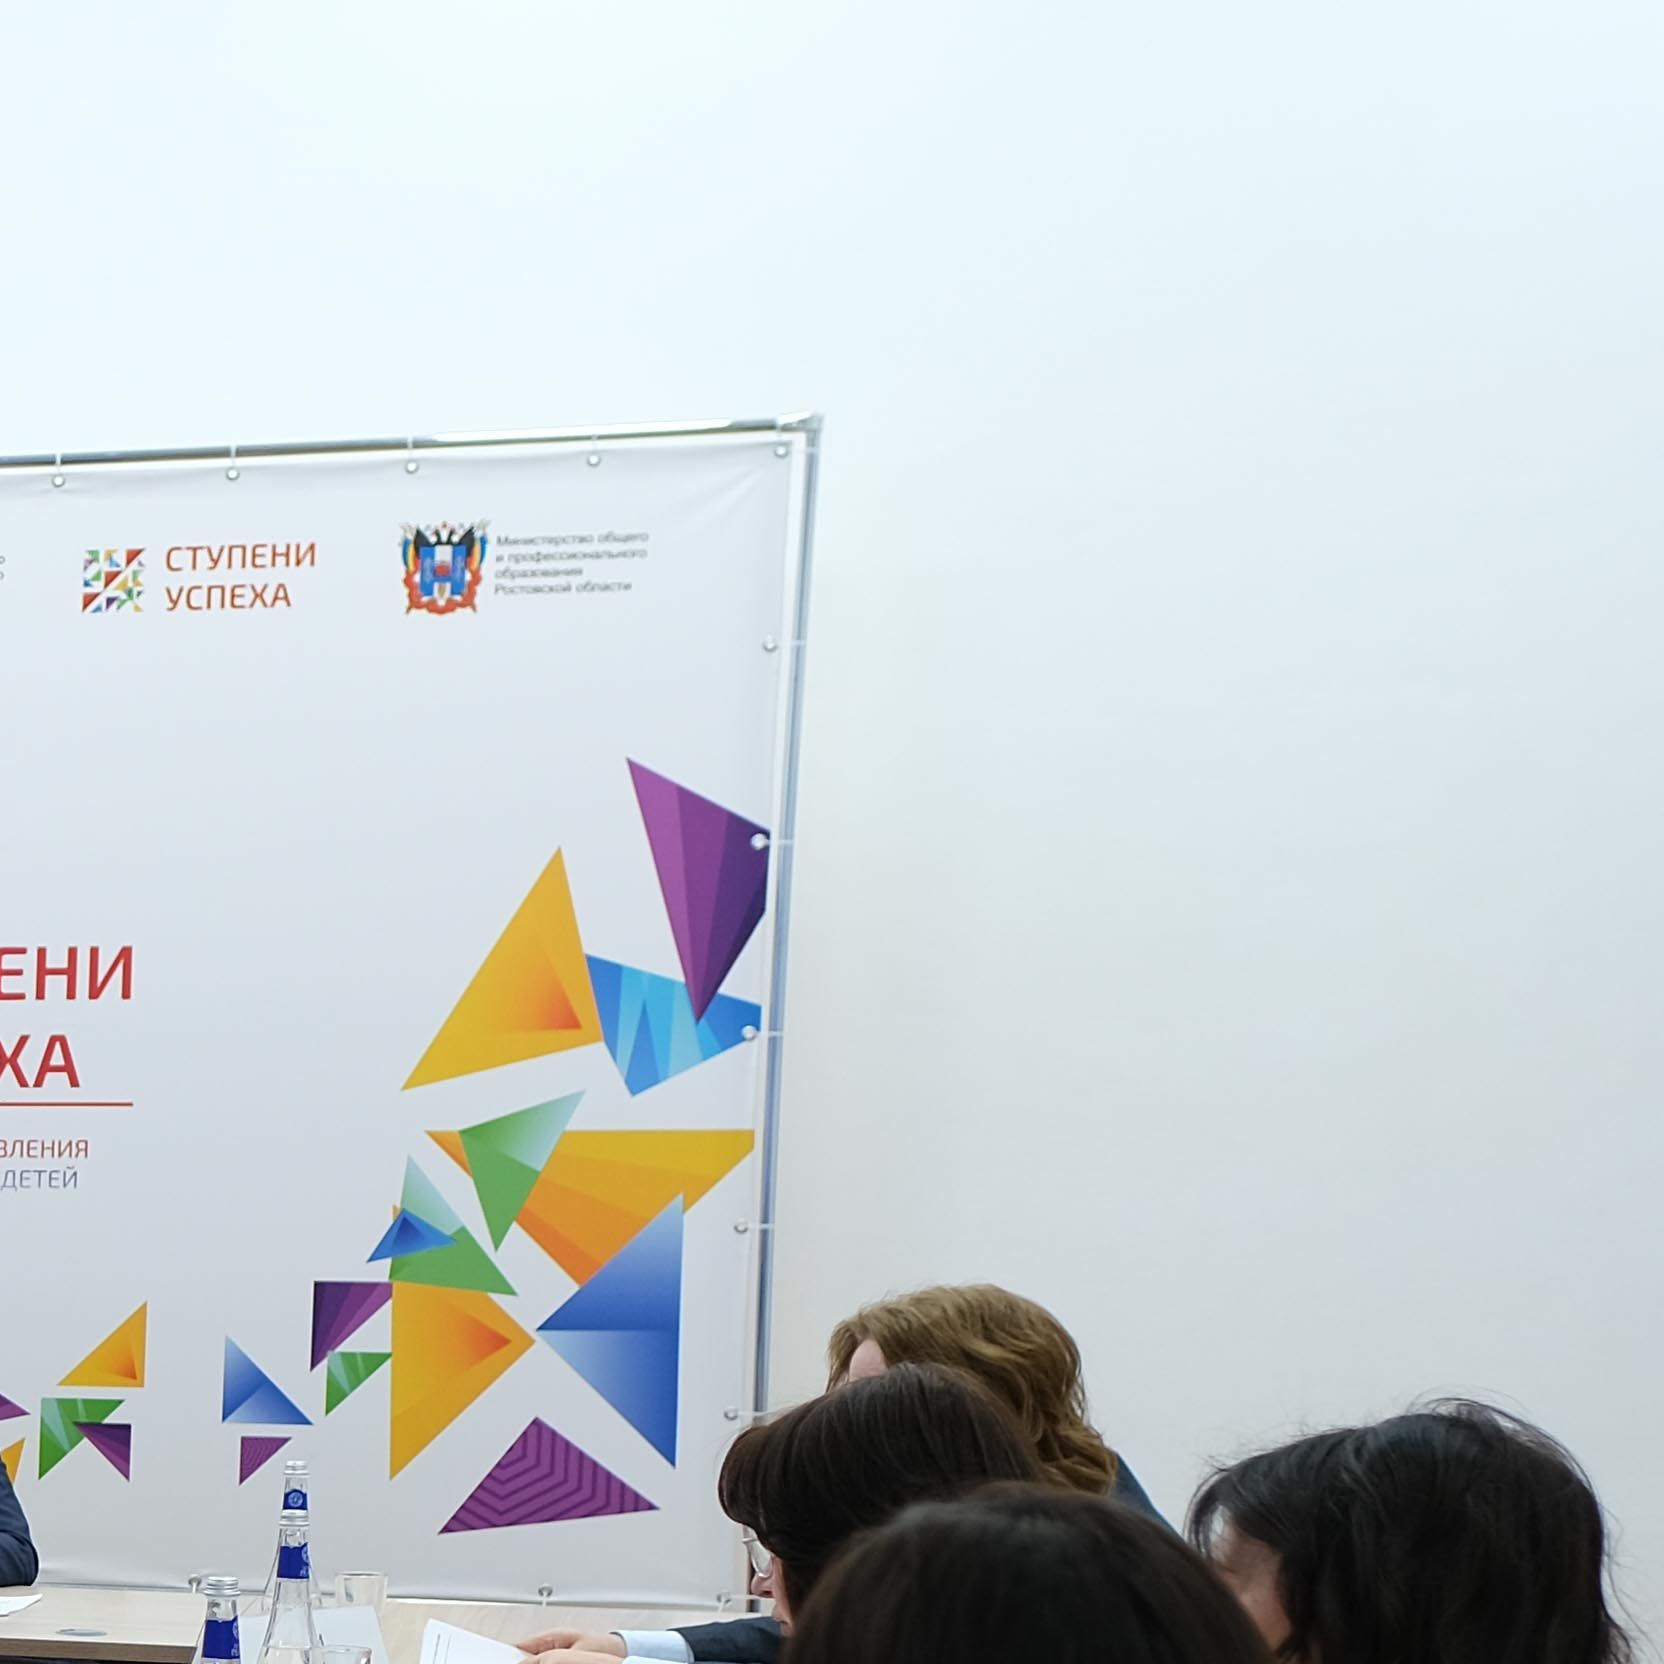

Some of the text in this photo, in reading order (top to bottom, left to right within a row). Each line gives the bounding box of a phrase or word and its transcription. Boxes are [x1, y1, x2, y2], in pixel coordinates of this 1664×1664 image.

[165, 542, 316, 572] СТУПЕНИ
[165, 582, 292, 612] УСПЕХА
[0, 1165, 78, 1193] ДЕТЕЙ
